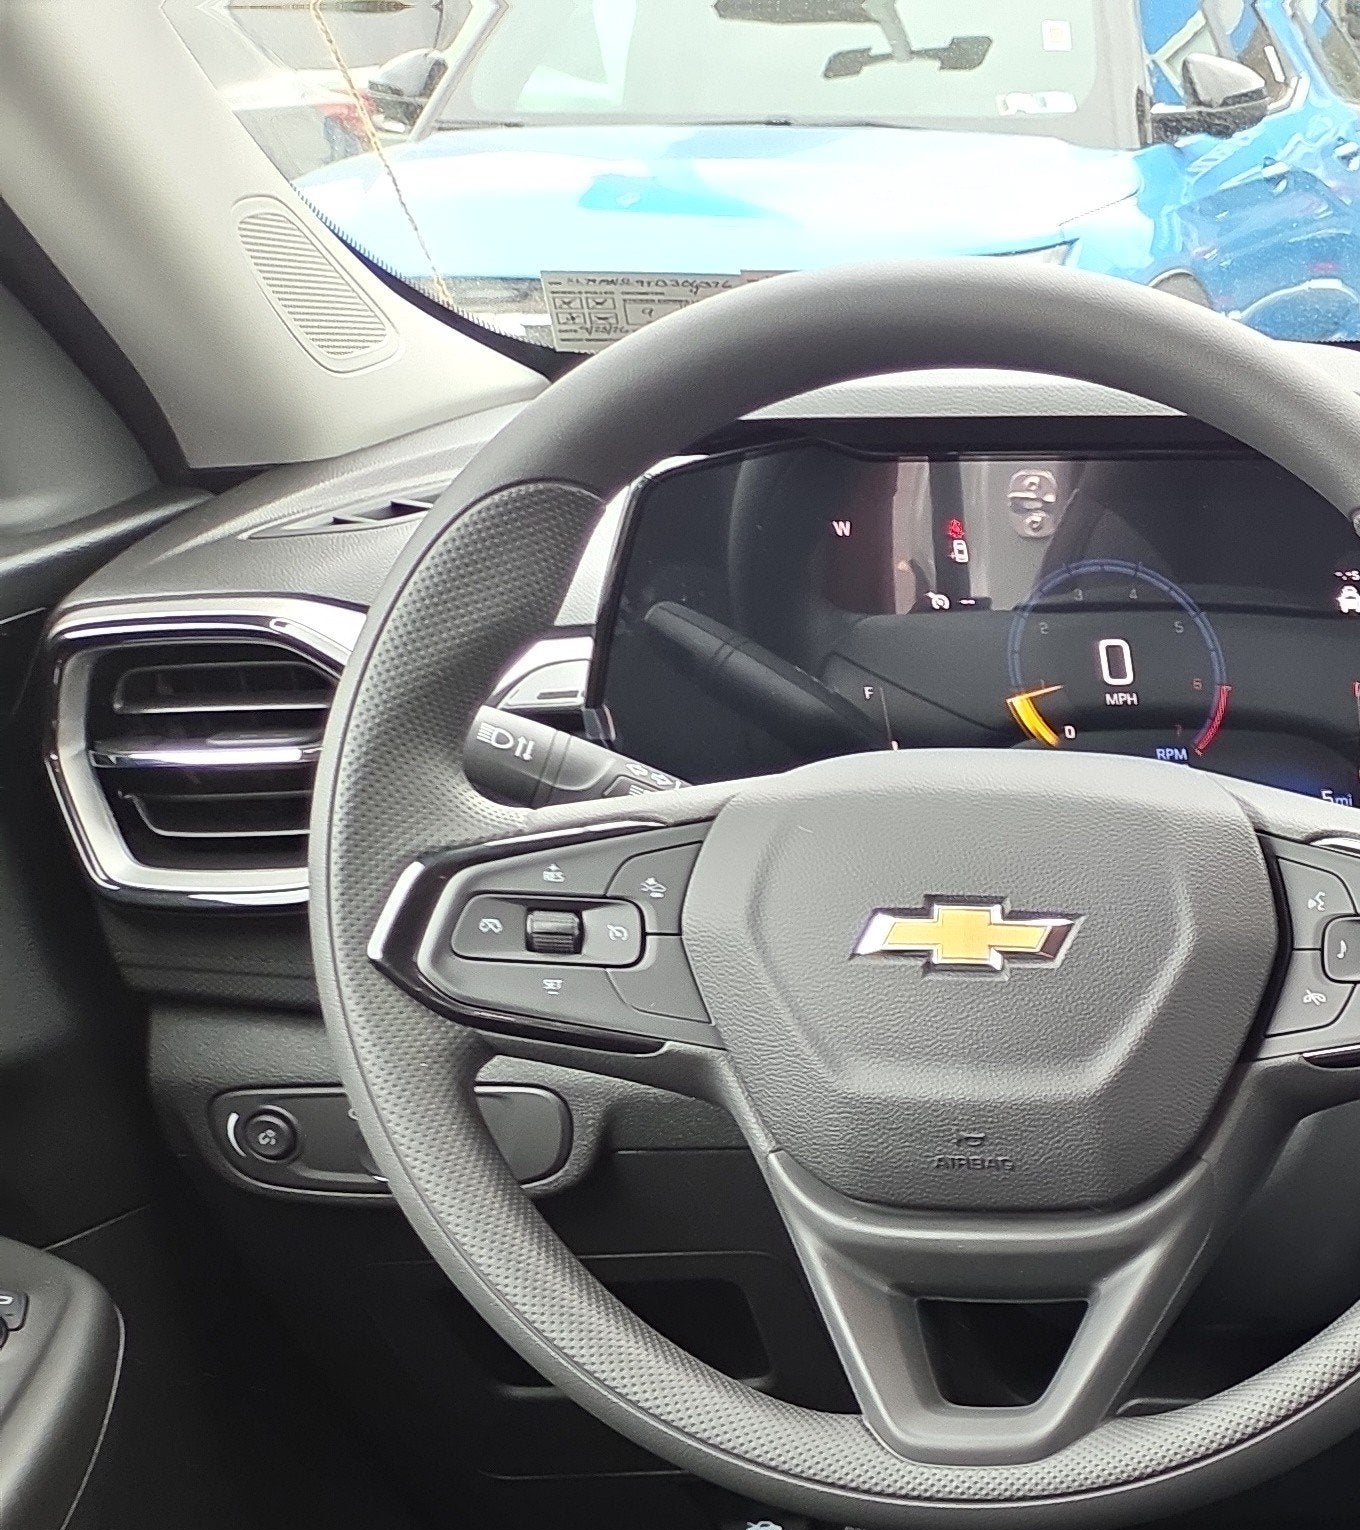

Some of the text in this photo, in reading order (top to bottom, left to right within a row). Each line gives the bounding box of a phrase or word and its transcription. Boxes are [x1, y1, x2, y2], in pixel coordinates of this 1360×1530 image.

[832, 520, 850, 537] W
[1073, 589, 1083, 600] 3
[1129, 589, 1138, 600] 4
[1039, 621, 1049, 634] 2
[1174, 621, 1184, 633] 5
[1098, 638, 1134, 686] 0
[863, 686, 874, 700] F
[1105, 693, 1138, 706] MPH
[1065, 726, 1076, 739] 0
[1155, 748, 1188, 761] RPM
